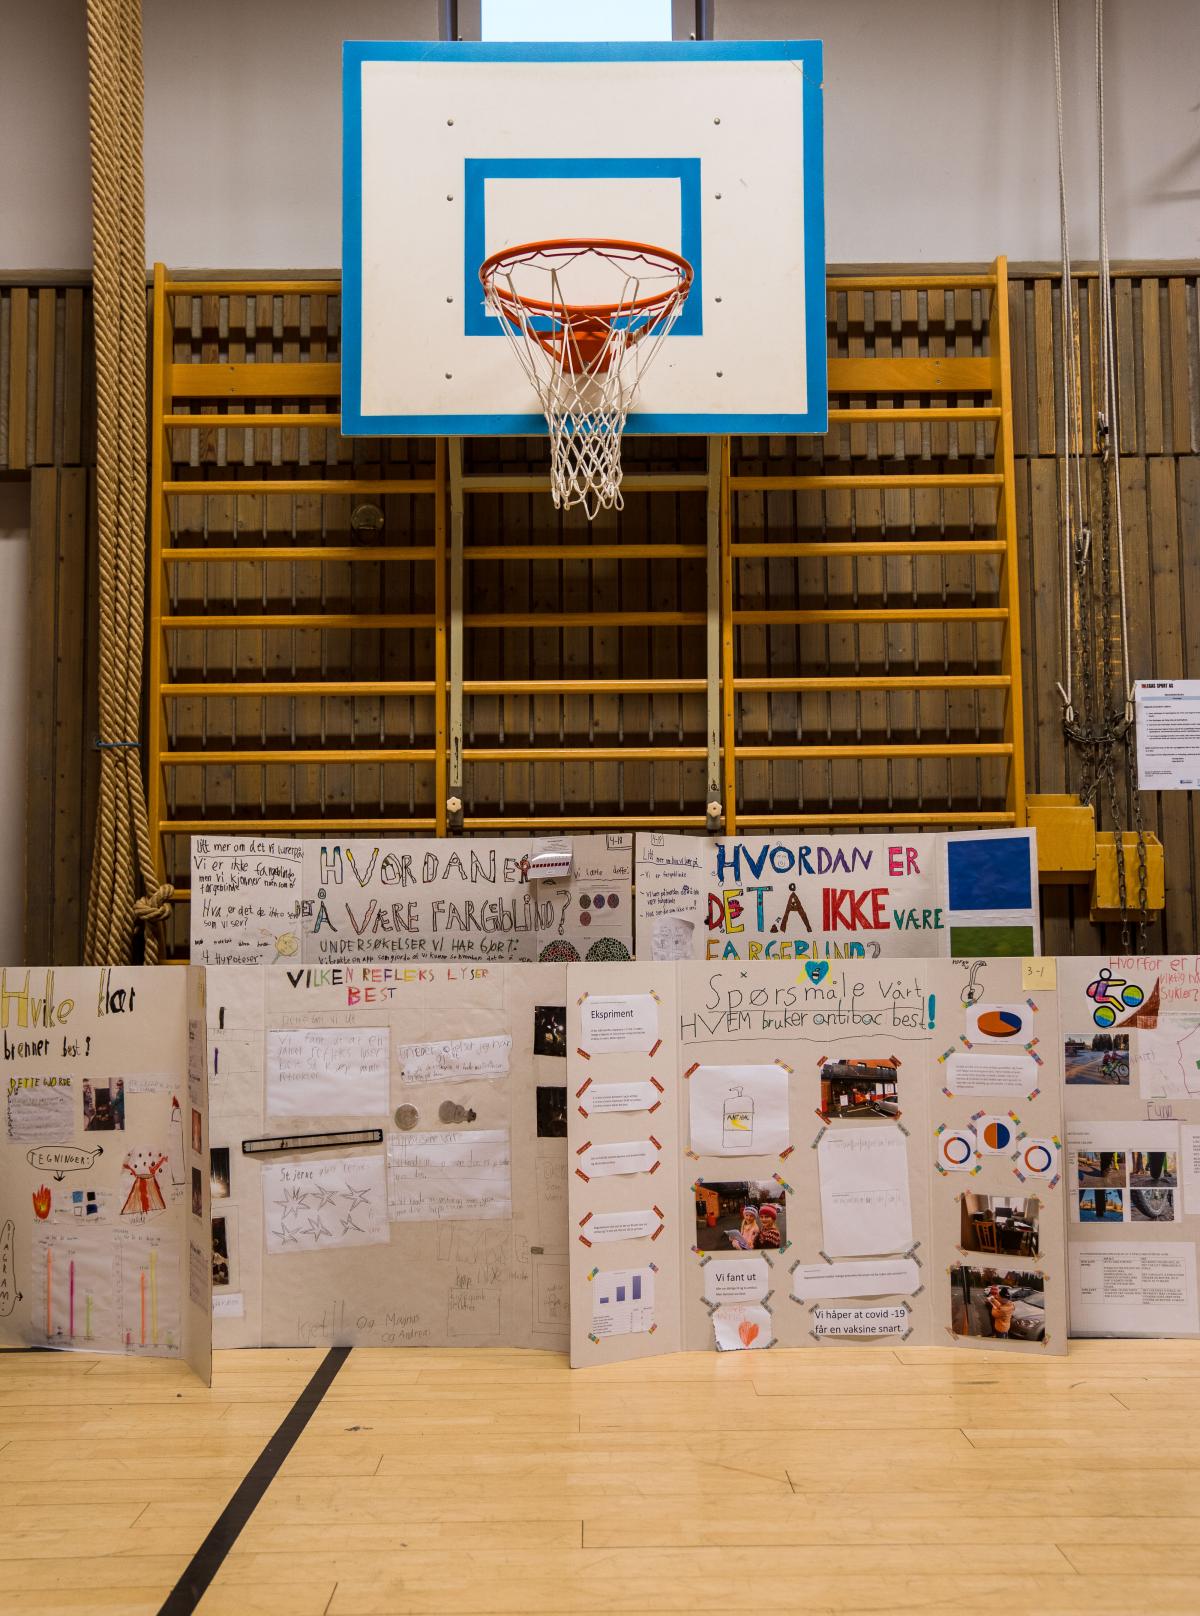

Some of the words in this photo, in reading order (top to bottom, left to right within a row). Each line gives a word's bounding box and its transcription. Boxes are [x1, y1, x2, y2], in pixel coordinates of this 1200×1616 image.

[214, 843, 231, 852] mer
[234, 844, 246, 852] om
[249, 840, 265, 852] det
[193, 856, 206, 870] Vi
[212, 861, 224, 871] er
[231, 857, 249, 872] ikke
[320, 846, 496, 887] HVORDAN
[714, 842, 874, 886] HVORDAN
[888, 846, 921, 877] ER
[199, 874, 212, 882] men
[230, 872, 261, 886] kjenner
[573, 868, 581, 879] Vi
[203, 899, 222, 917] Hva
[228, 906, 237, 914] er
[238, 905, 253, 916] det
[256, 907, 266, 916] de
[314, 888, 338, 933] Å
[345, 899, 419, 935] VÆRE
[822, 887, 891, 932] IKKE
[893, 908, 945, 930] VÆRE
[203, 920, 217, 928] som
[220, 920, 229, 929] vi
[452, 939, 475, 951] HAR
[1109, 956, 1163, 971] Hvorfor
[1169, 957, 1188, 971] er
[286, 968, 353, 988] VILKEN
[362, 968, 435, 983] REFLEKS
[447, 968, 489, 981] LYSER
[347, 986, 397, 1006] BEST
[591, 1009, 634, 1020] Ekspriment
[680, 1011, 752, 1041] HVEM
[761, 1007, 809, 1030] bruker
[813, 999, 882, 1030] antibac
[3, 1030, 50, 1061] brenner
[10, 1077, 40, 1089] DETTE
[29, 1151, 91, 1166] TEGNINGER:
[715, 1273, 725, 1282] Vi
[726, 1272, 745, 1282] fant
[746, 1273, 757, 1281] ut
[814, 1310, 824, 1319] Vi
[826, 1309, 851, 1321] håper
[854, 1311, 863, 1319] at
[865, 1309, 889, 1319] covid
[890, 1309, 906, 1318] -19
[815, 1324, 828, 1334] får
[843, 1324, 877, 1334] vaksine
[878, 1324, 904, 1333] snart.
